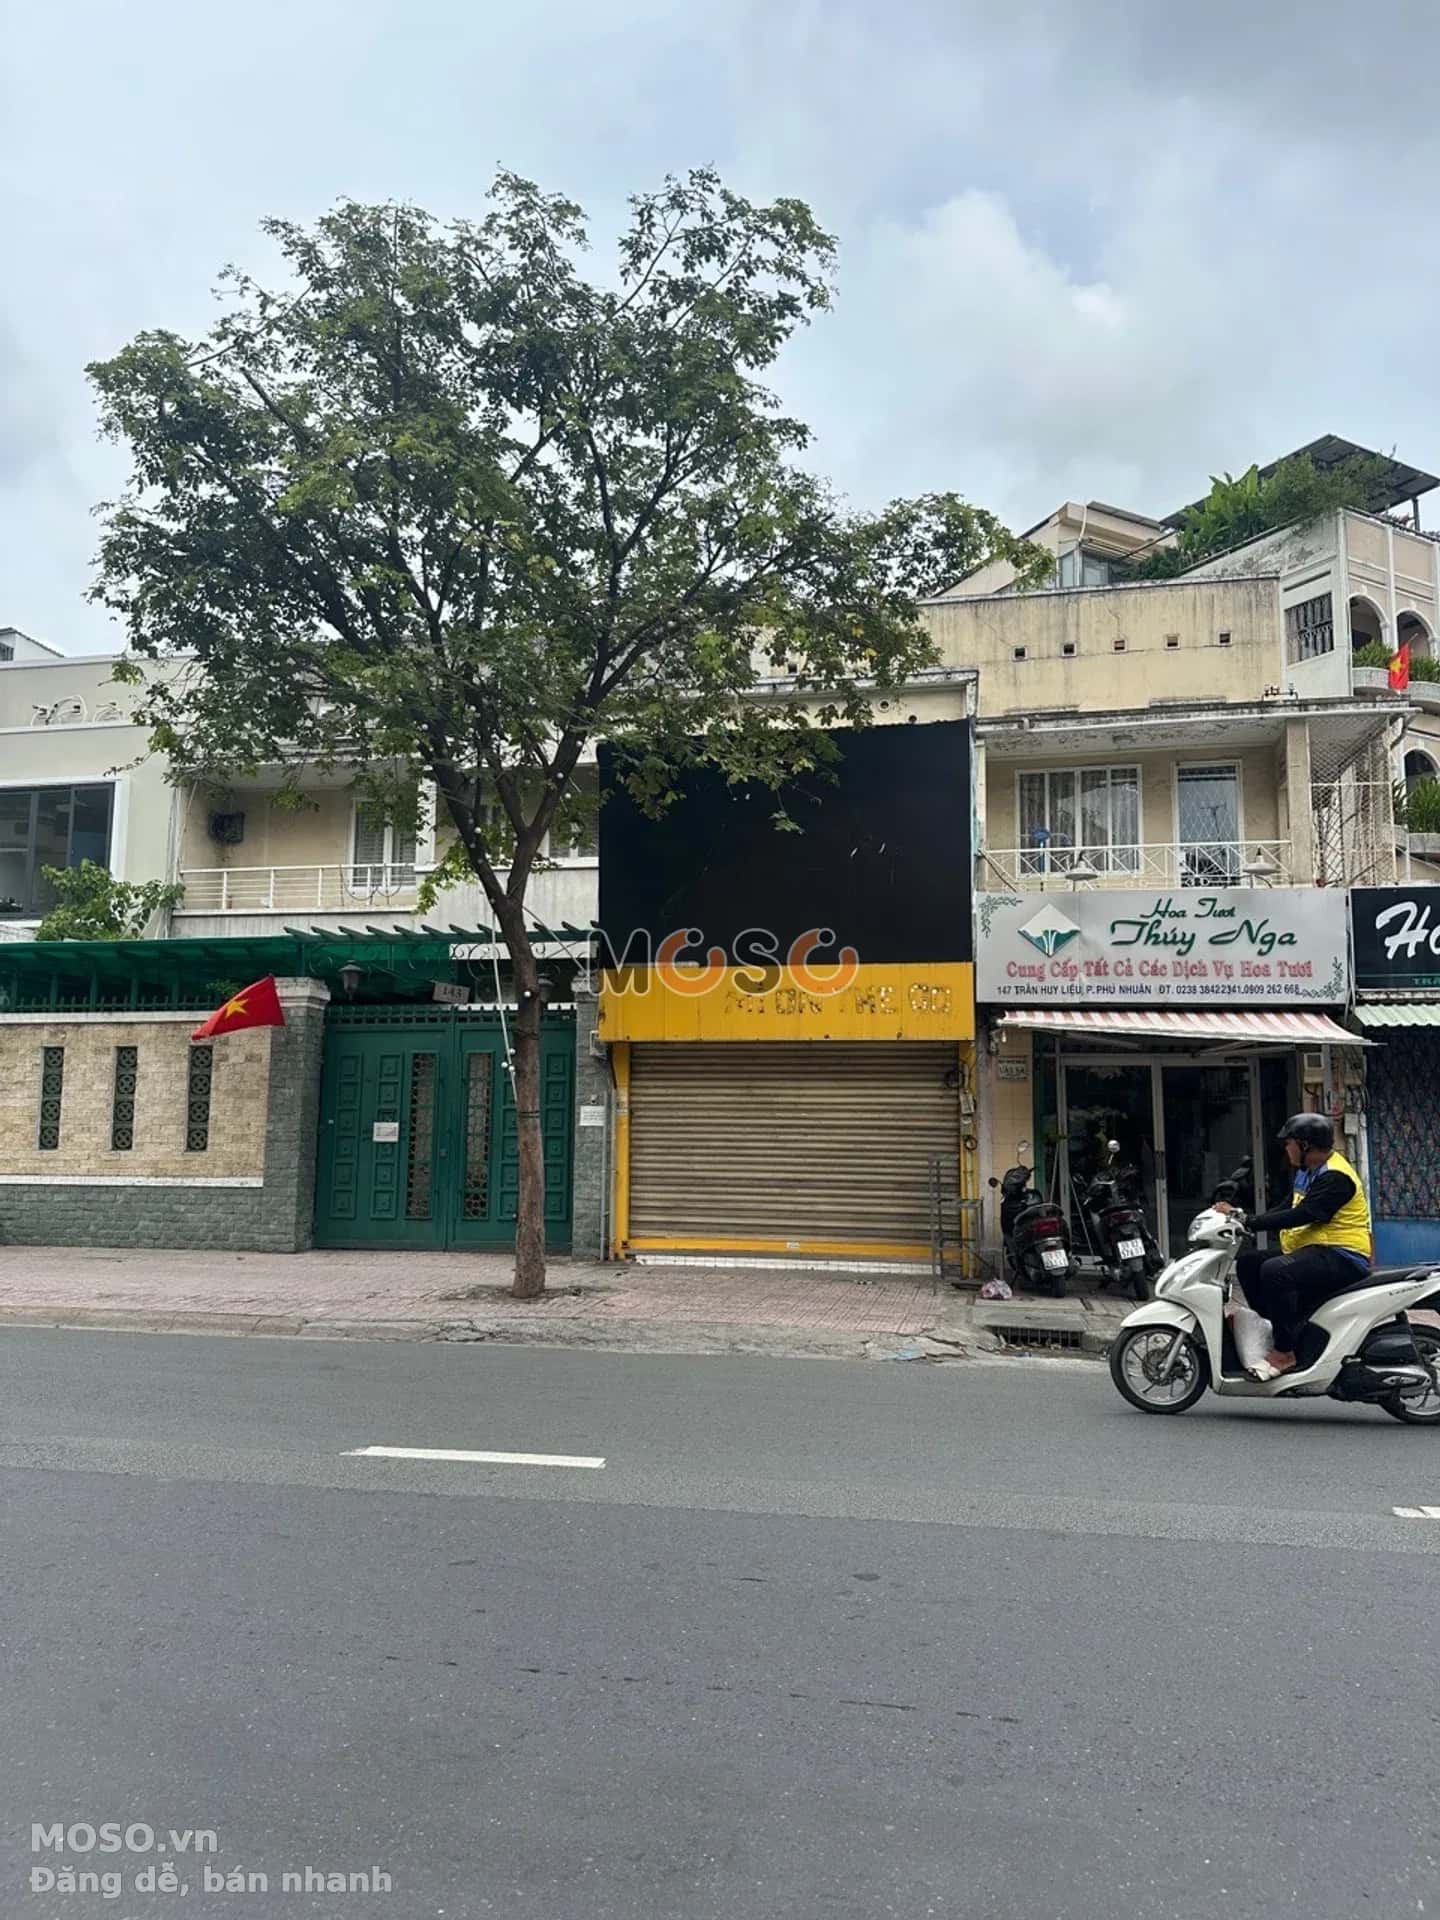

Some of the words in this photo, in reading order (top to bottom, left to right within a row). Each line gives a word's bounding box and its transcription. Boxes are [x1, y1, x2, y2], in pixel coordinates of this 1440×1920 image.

[1139, 898, 1187, 919] Hoa
[1110, 920, 1196, 956] Thúy
[1208, 919, 1298, 956] Nga
[1006, 961, 1046, 982] Cung
[1138, 957, 1168, 977] Các
[1172, 959, 1208, 980] Dịch
[1240, 960, 1272, 978] Hoa
[1040, 985, 1060, 994] HUY
